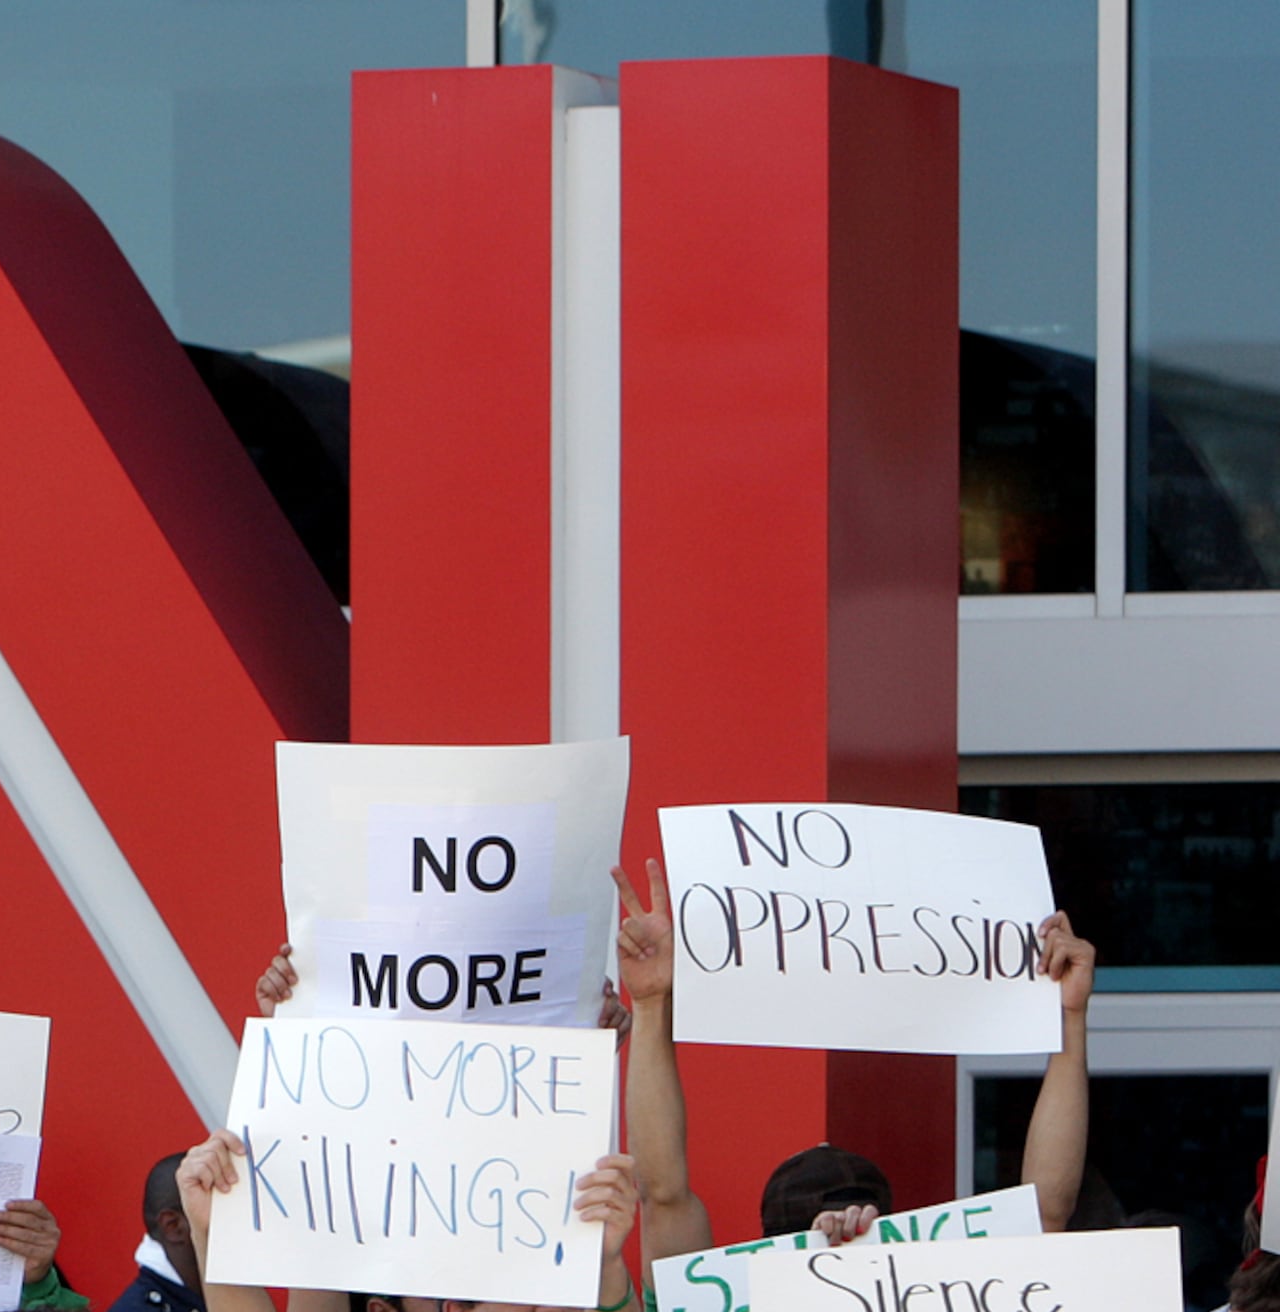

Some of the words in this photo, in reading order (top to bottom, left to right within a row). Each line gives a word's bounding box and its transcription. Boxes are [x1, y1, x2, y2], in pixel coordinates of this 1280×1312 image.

[412, 835, 516, 893] NO
[728, 809, 851, 869] NO
[349, 948, 548, 1011] MORE
[258, 1026, 371, 1110] NO
[401, 1039, 587, 1119] MORE
